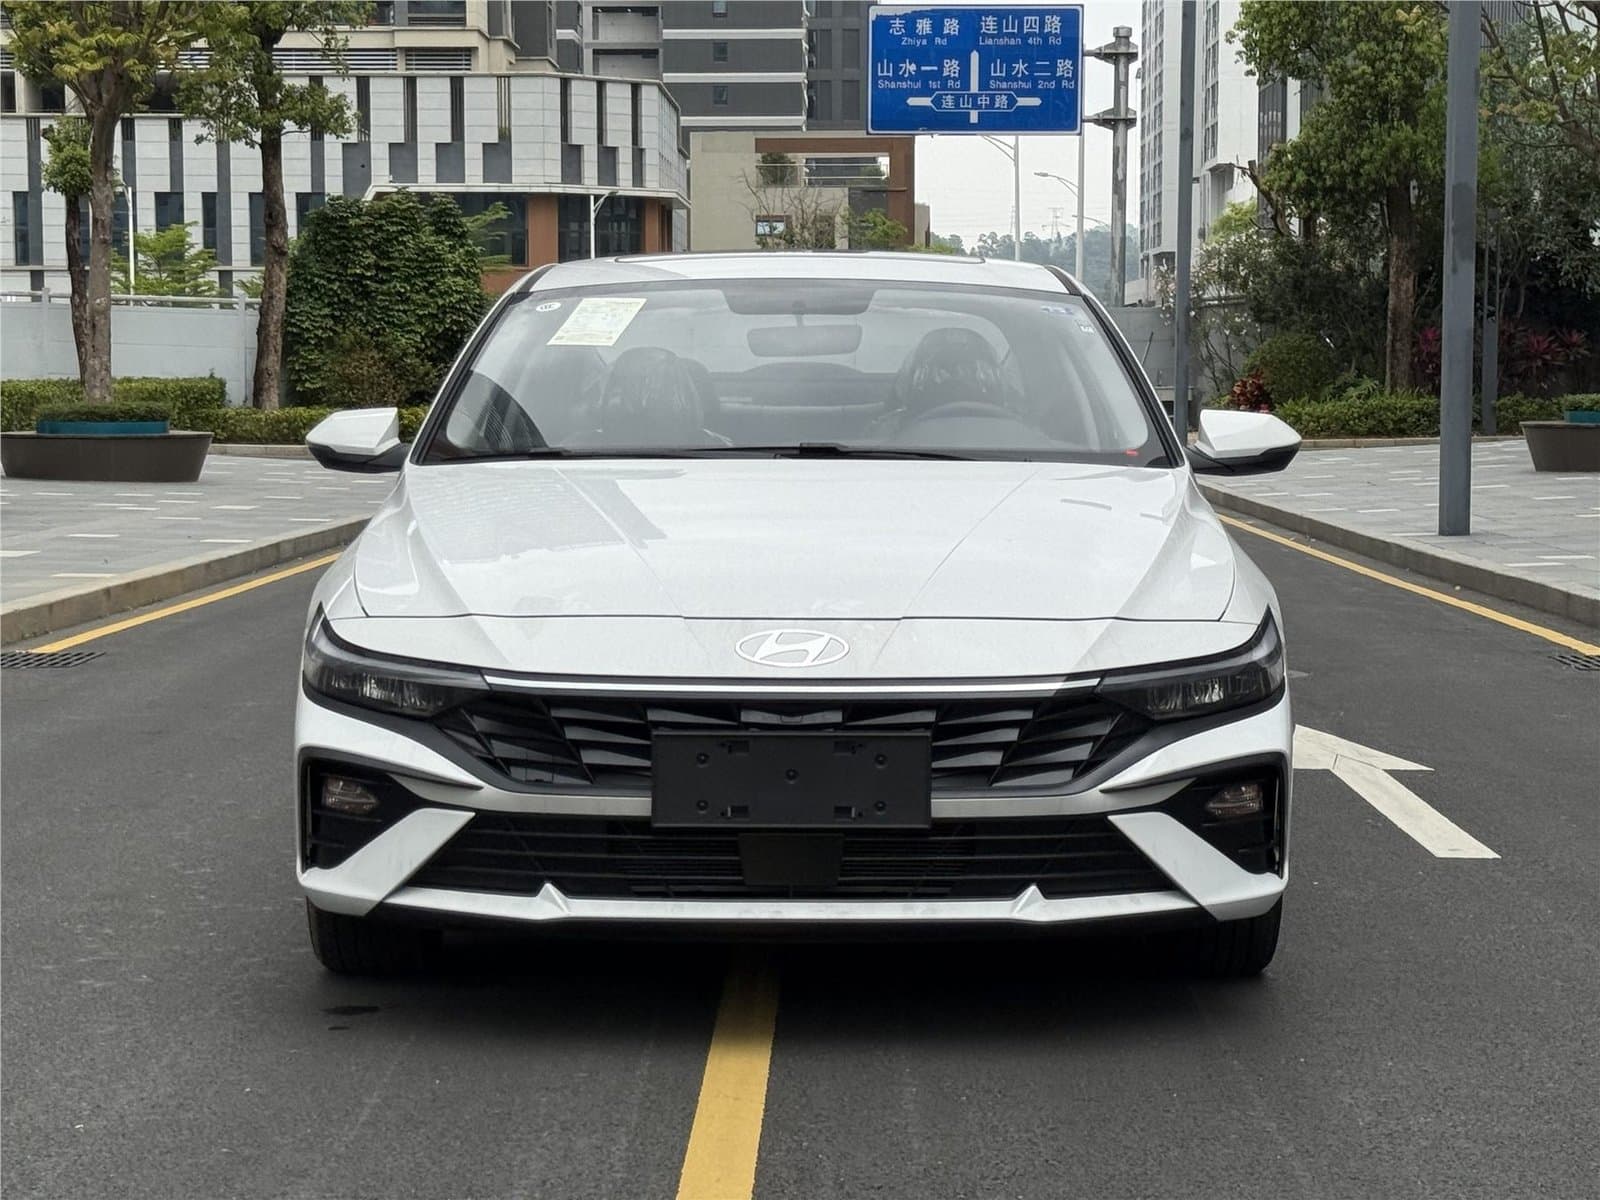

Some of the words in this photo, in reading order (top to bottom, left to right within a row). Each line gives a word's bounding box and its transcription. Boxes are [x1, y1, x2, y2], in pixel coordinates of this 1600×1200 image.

[890, 18, 960, 35] 志雅路
[980, 16, 1062, 34] 连山四路
[901, 37, 927, 46] Zhiya
[935, 37, 947, 45] Rd
[979, 37, 1021, 45] Lianshan
[1028, 37, 1042, 45] 4th
[1049, 37, 1061, 45] Rd
[878, 59, 960, 77] 山水一路
[991, 59, 1074, 77] 山水二路
[878, 80, 922, 88] Shanshui
[929, 80, 940, 88] 1st
[948, 80, 960, 88] Rd
[989, 80, 1032, 88] Shanshui
[1038, 80, 1055, 88] 2nd
[1062, 80, 1075, 88] Rd
[941, 94, 1008, 109] 连山中路
